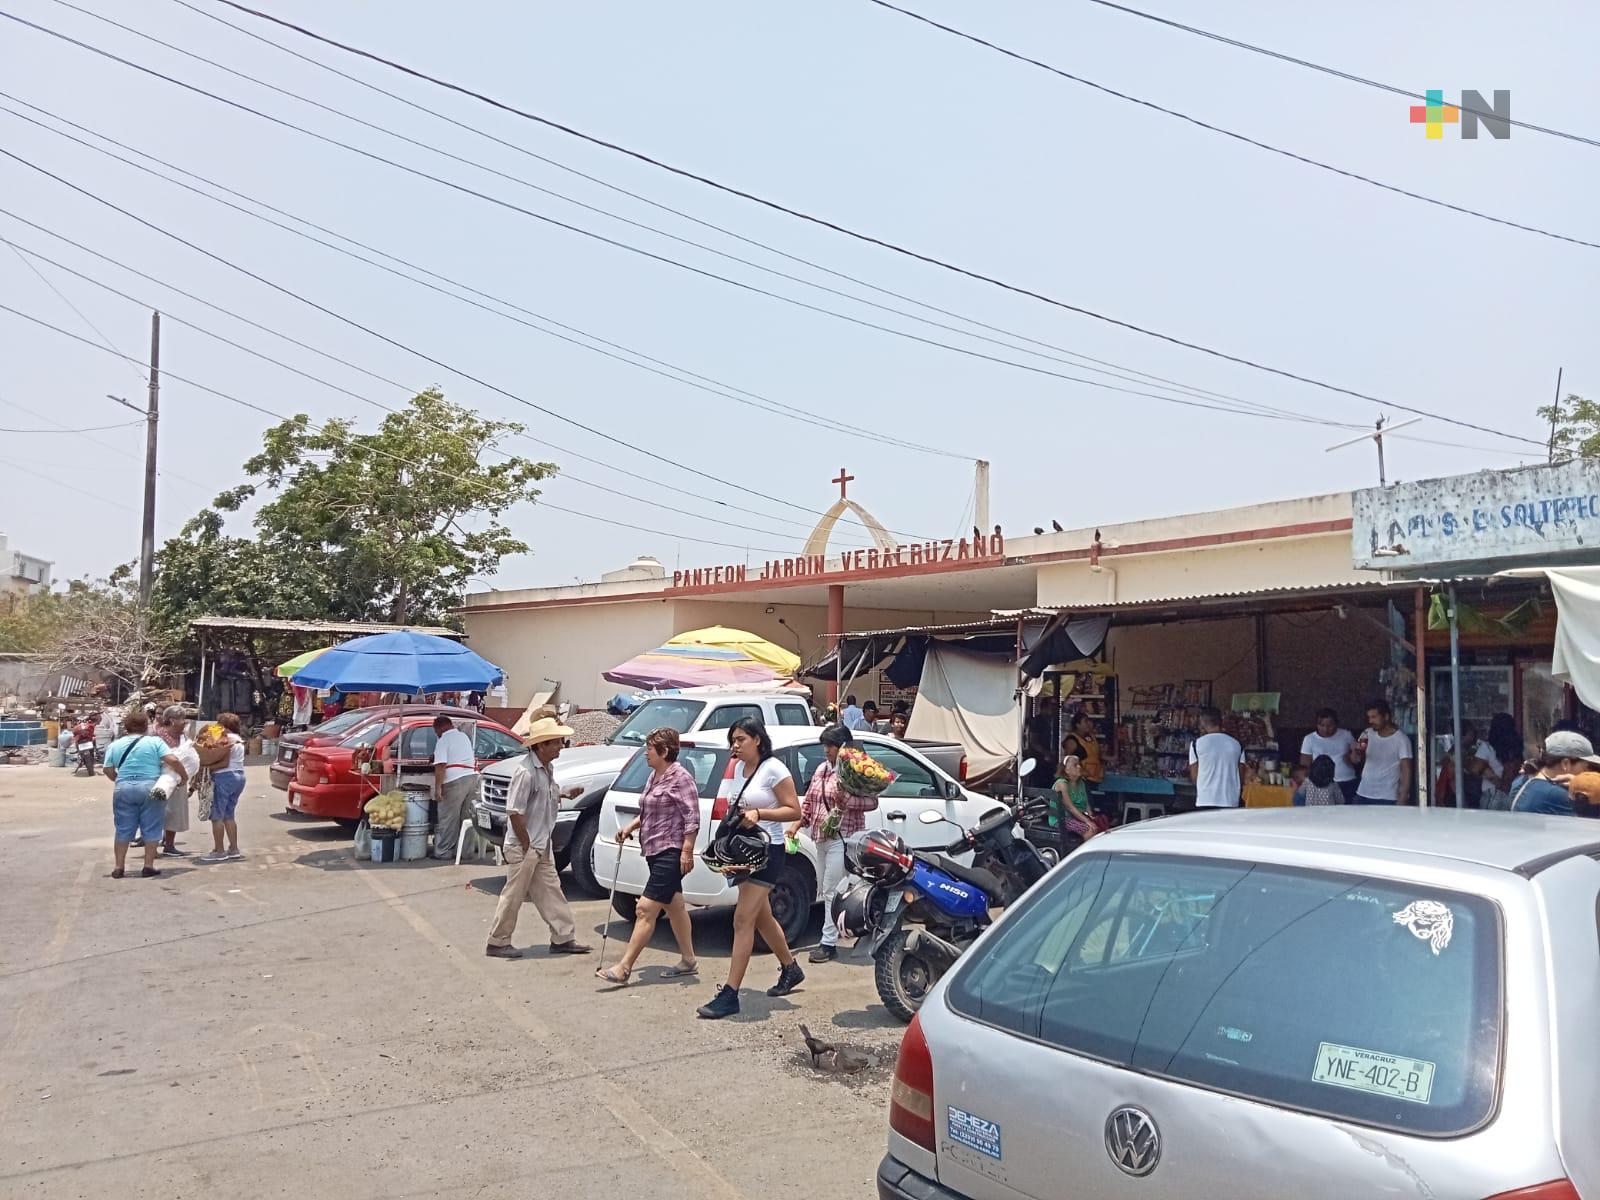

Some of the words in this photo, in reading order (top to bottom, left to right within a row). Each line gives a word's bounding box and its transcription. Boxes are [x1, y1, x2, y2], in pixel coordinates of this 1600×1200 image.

[673, 564, 746, 587] PANTEON
[760, 554, 825, 580] JARDIN
[841, 534, 1004, 571] VERACRUZANO
[1327, 1056, 1420, 1092] YNE-402-B
[1355, 1051, 1397, 1064] VERACRUZ
[948, 1105, 998, 1136] DEHEZA
